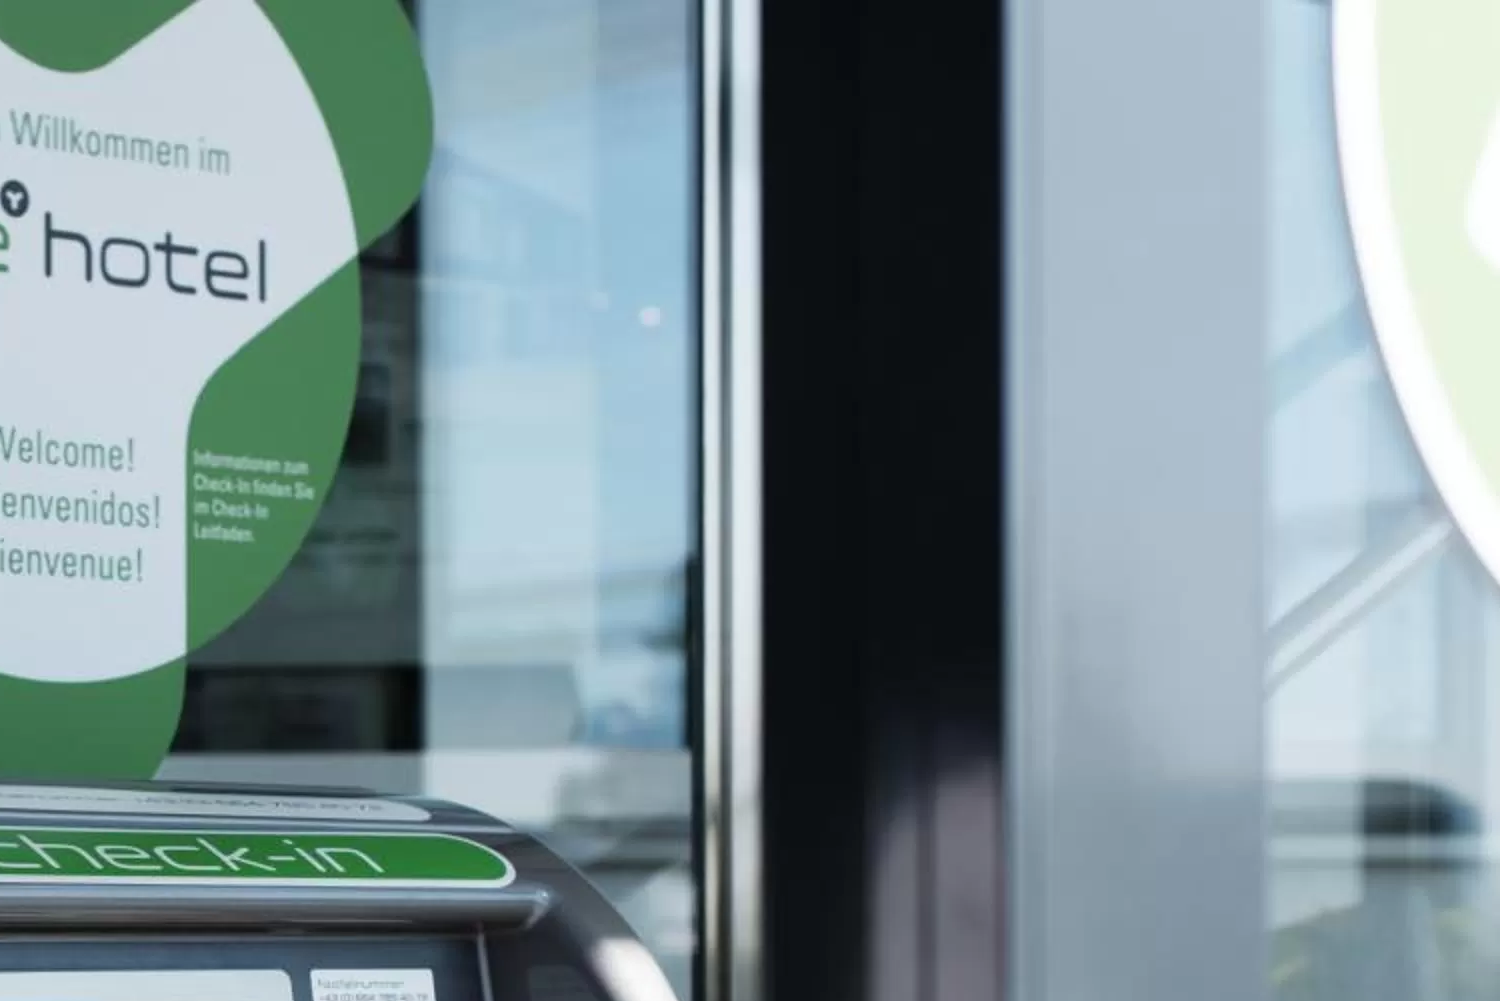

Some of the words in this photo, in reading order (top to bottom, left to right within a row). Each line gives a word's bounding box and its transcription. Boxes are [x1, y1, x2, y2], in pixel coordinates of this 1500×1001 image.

[10, 108, 190, 169] Willkommen
[198, 136, 231, 176] im
[44, 211, 268, 303] hotel
[293, 481, 315, 500] Sie
